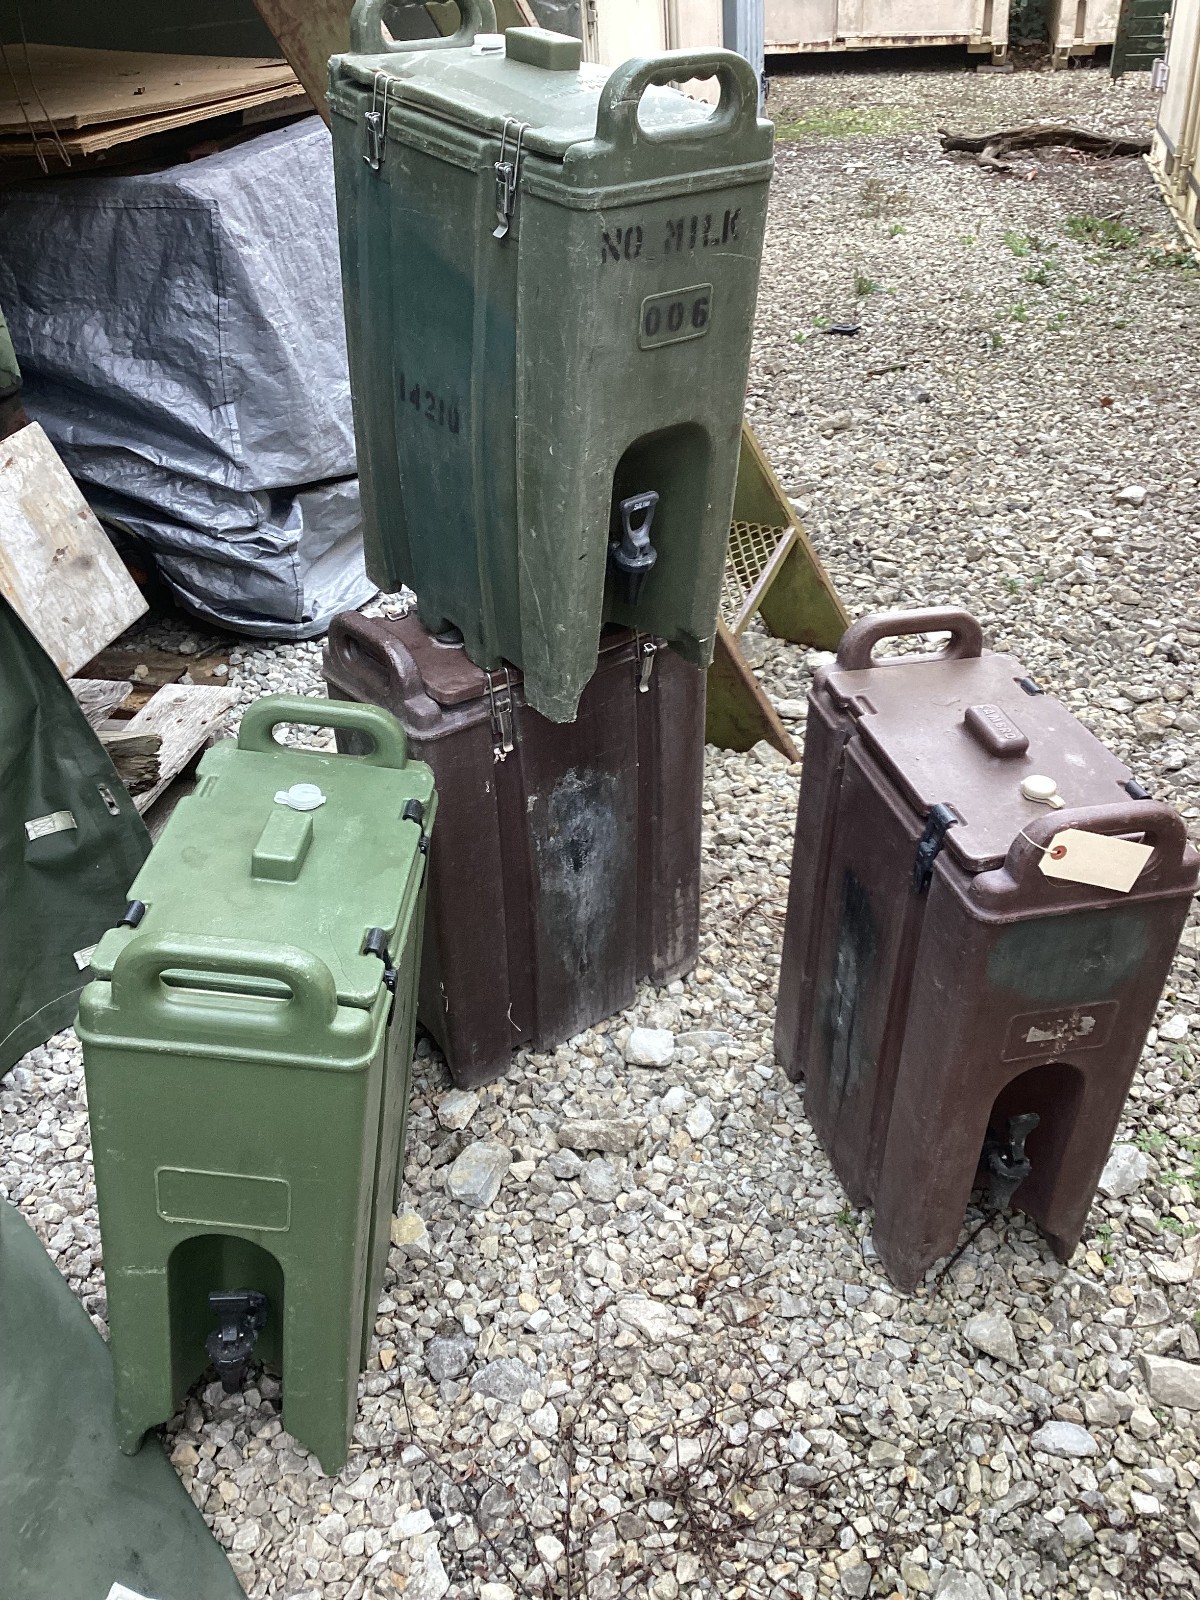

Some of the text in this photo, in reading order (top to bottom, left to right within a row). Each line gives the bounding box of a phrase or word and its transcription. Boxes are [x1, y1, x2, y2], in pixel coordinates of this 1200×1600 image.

[601, 207, 742, 264] NO MILK
[645, 297, 709, 337] 006
[400, 372, 460, 434] 14210
